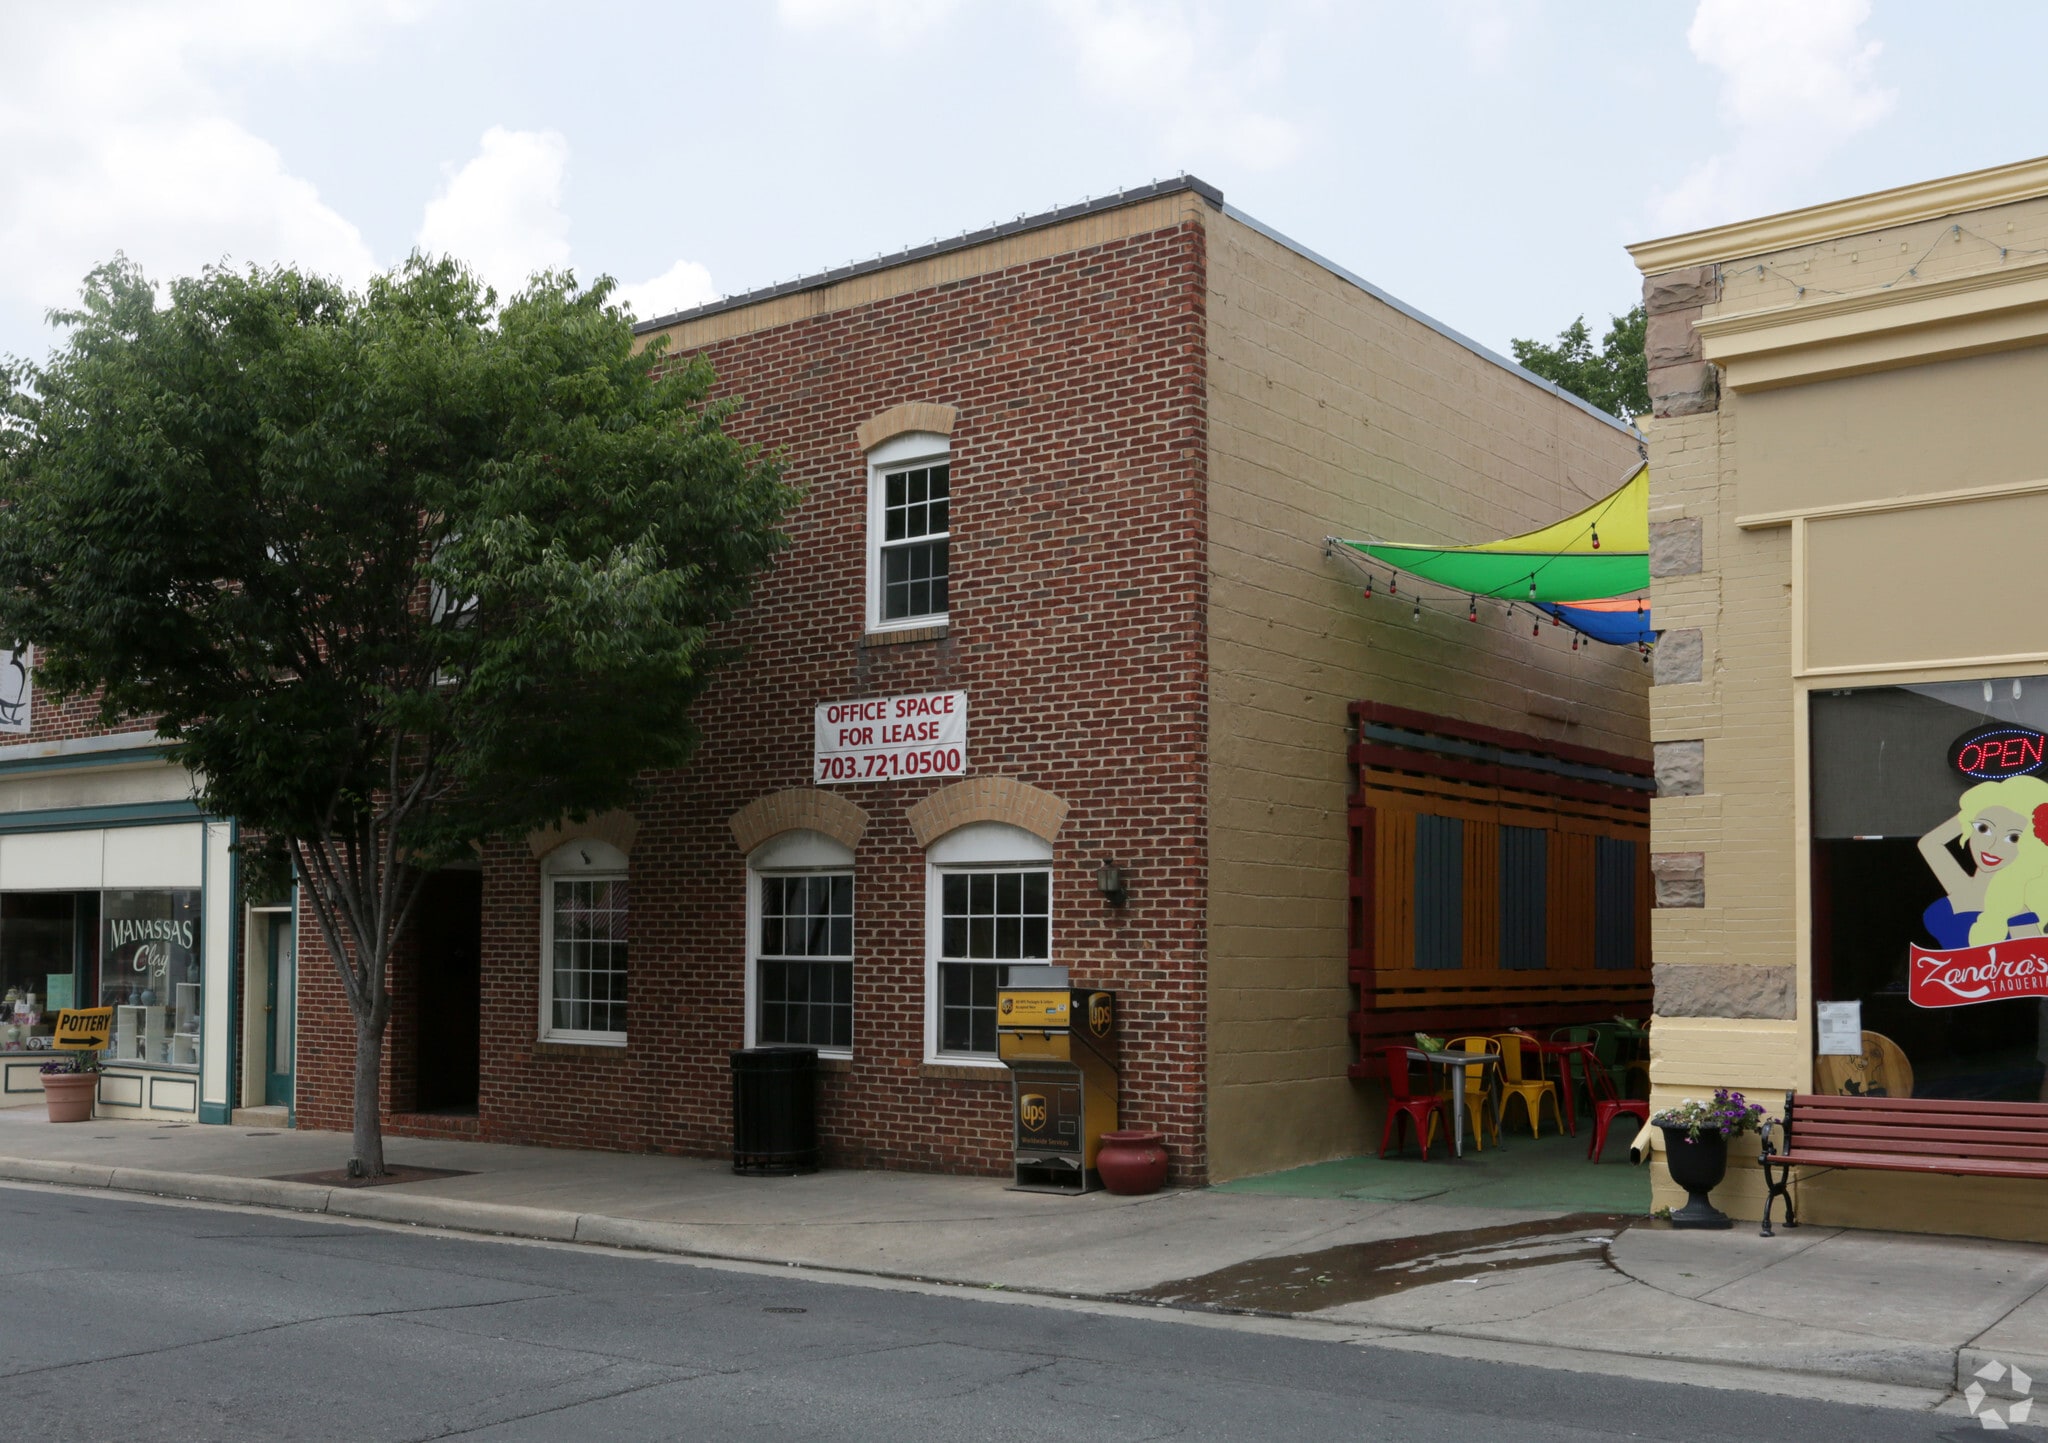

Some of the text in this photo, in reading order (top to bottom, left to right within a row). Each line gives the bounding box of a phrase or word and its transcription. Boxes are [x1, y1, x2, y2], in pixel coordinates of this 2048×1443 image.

[827, 695, 954, 724] OFFICE SPACE
[839, 721, 939, 747] FOR LEASE
[819, 748, 961, 780] 703.721.0500
[1957, 735, 2045, 772] OPEN
[110, 919, 193, 952] MANASSAS
[133, 943, 169, 978] Clay
[1917, 947, 2048, 998] Zandra's
[60, 1013, 111, 1032] POTTERY
[1091, 1006, 1110, 1032] ups
[1023, 1105, 1045, 1126] ups
